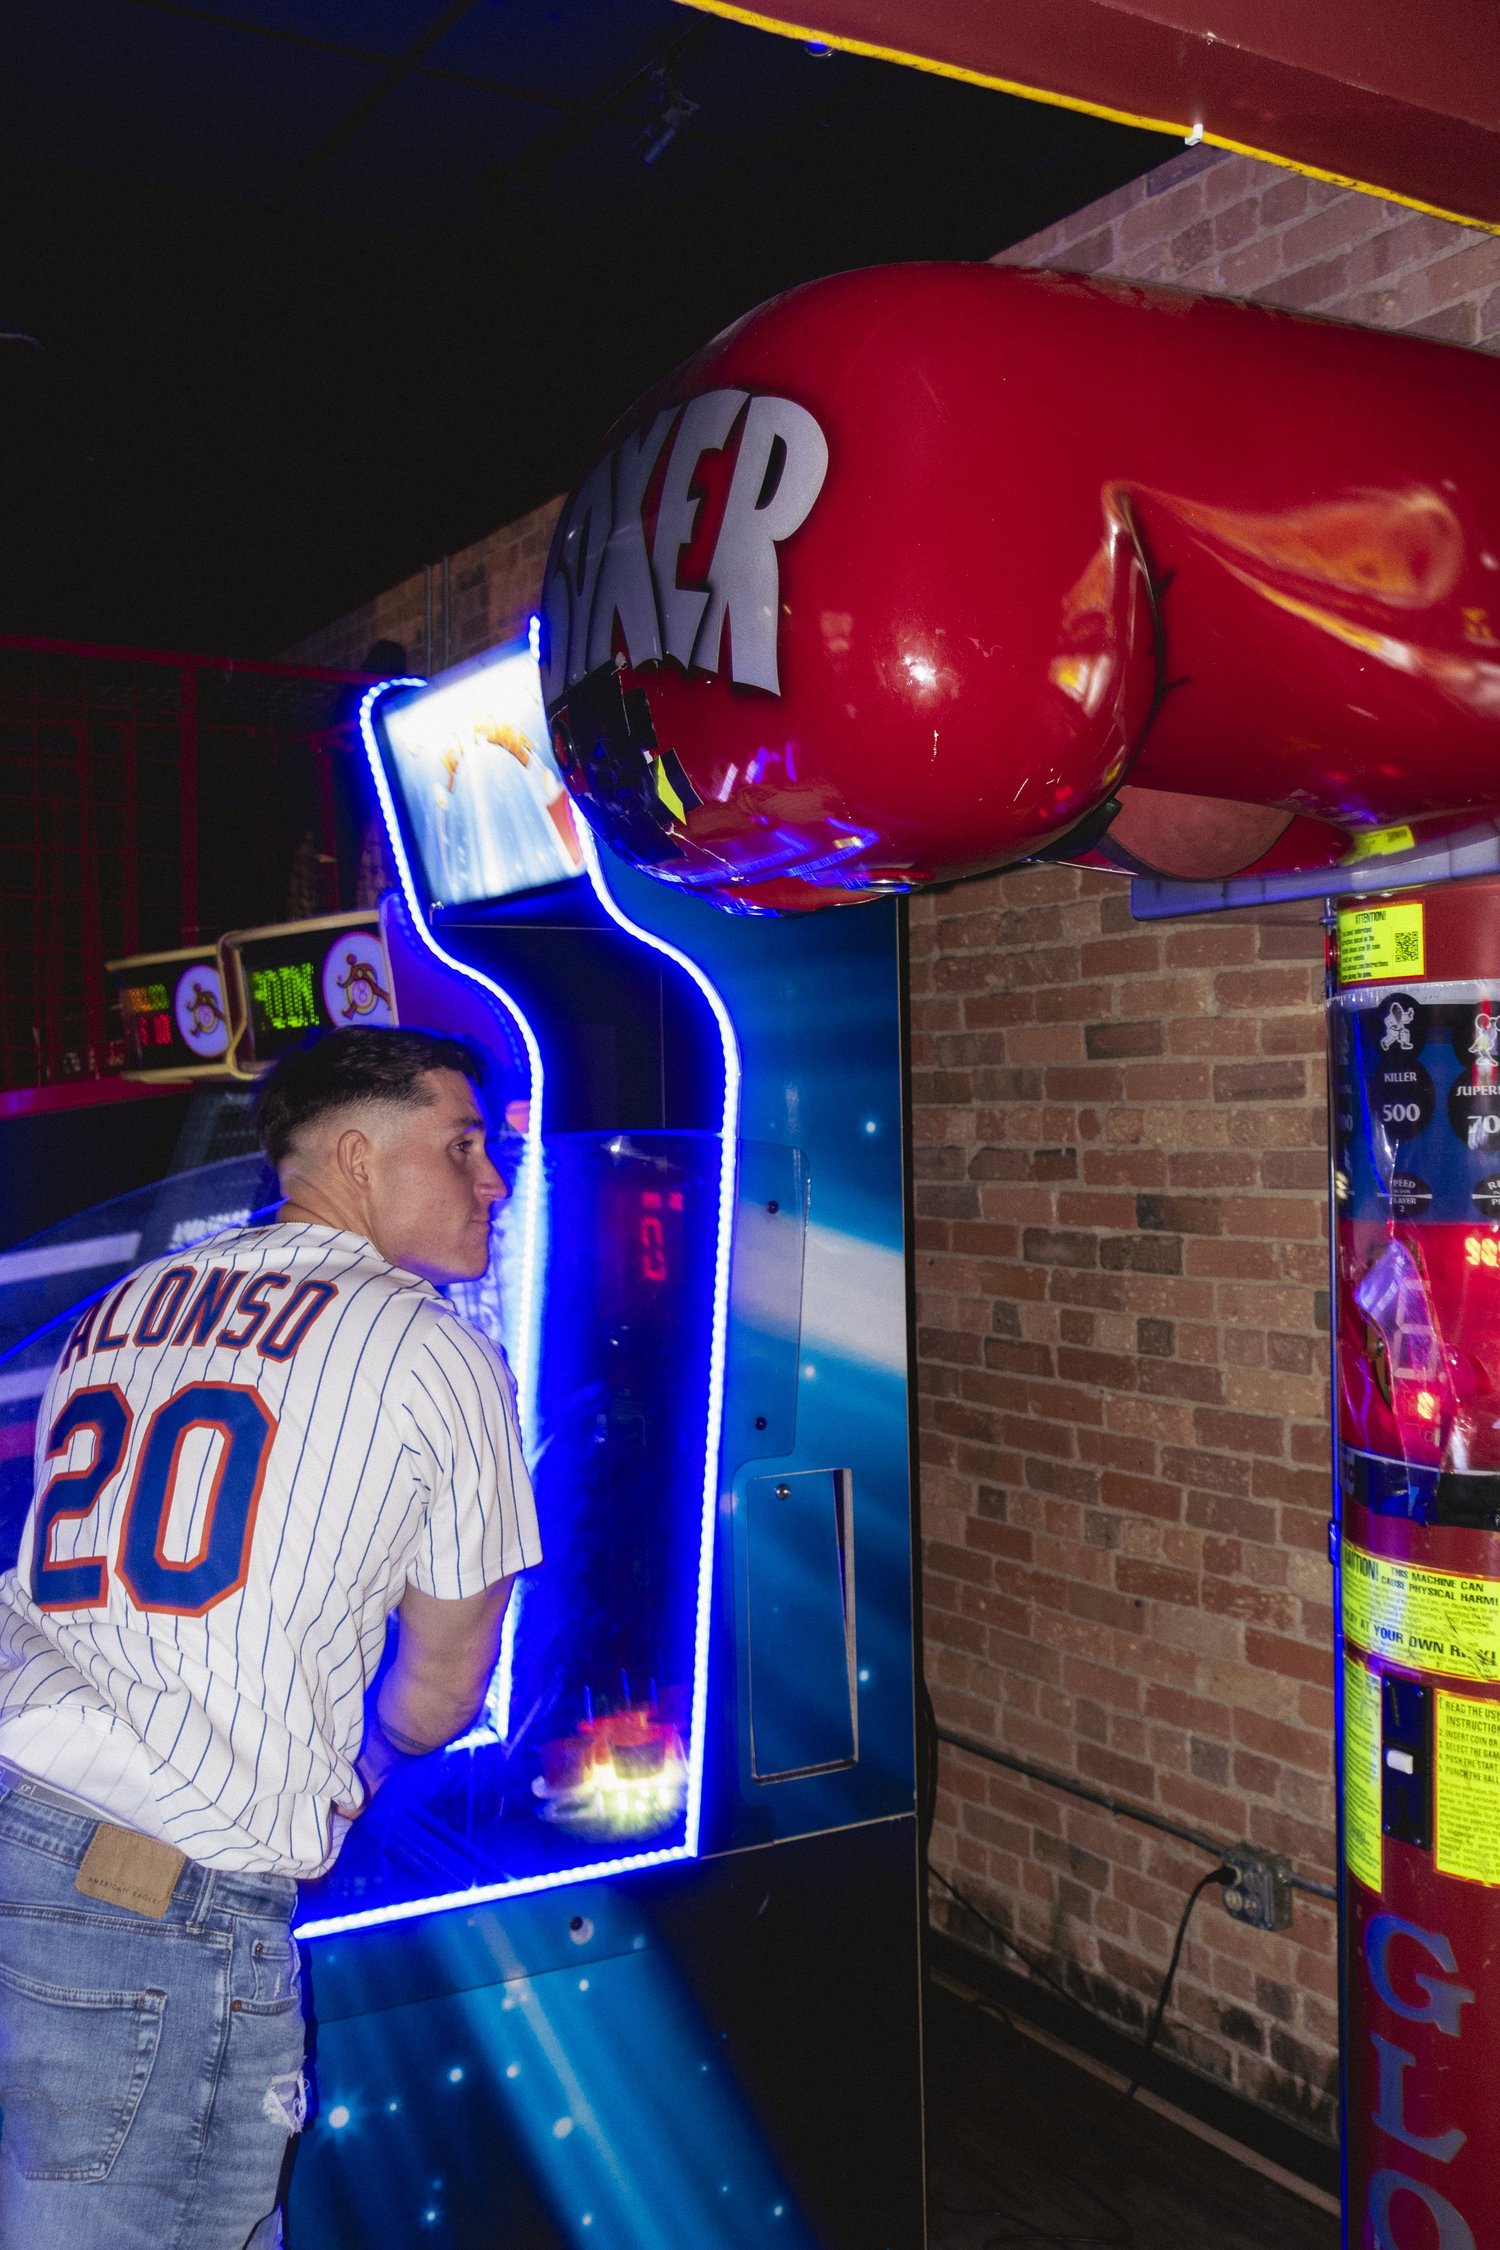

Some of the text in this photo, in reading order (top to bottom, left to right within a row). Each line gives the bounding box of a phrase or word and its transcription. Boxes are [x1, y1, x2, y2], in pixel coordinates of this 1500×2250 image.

[541, 389, 828, 697] OXER
[1384, 1072, 1418, 1082] KILLER
[1383, 1103, 1421, 1122] 500
[1393, 1180, 1416, 1189] PEED
[1393, 1197, 1417, 1205] LAYER
[60, 1265, 340, 1375] ALONSO
[30, 1380, 279, 1618] 20
[1391, 1566, 1484, 1592] THIS MACHINE CAN
[1381, 1576, 1499, 1606] CAUSE PHYSICAL HARM!
[1374, 1625, 1404, 1644] YOUR
[1409, 1635, 1444, 1654] OWN
[1445, 1700, 1466, 1714] READ
[1468, 1705, 1482, 1717] THE
[1445, 1730, 1469, 1741] INSERT
[1470, 1735, 1487, 1745] COIN
[1488, 1738, 1498, 1747] OR
[1445, 1741, 1469, 1754] SELECT
[1470, 1747, 1482, 1757] THE
[1445, 1754, 1462, 1765] PUSH
[1463, 1758, 1476, 1768] THE
[1477, 1760, 1498, 1773] START
[1445, 1766, 1469, 1779] PUNCH
[1469, 1771, 1482, 1781] THE
[1484, 1774, 1499, 1785] BALL
[88, 1877, 157, 1905] AMERICAN EAGLE
